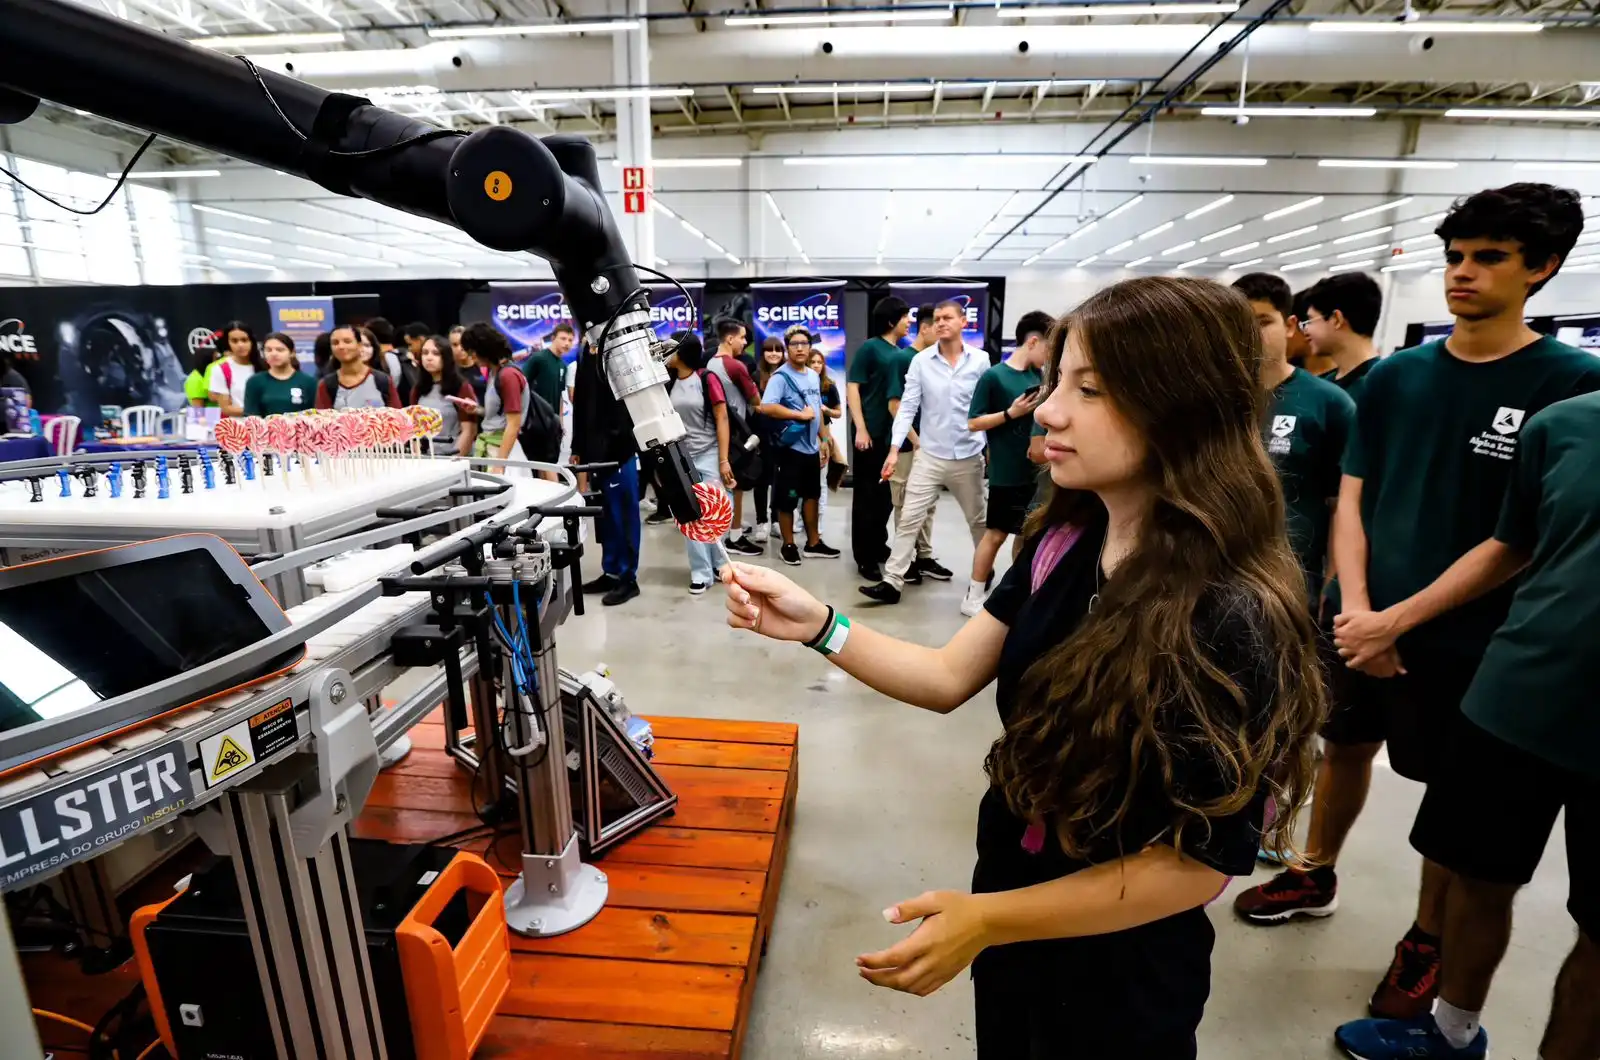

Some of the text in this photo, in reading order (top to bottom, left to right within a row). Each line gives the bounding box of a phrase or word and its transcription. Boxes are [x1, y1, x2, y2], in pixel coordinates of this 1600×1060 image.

[497, 304, 572, 319] SCIENCE
[649, 307, 698, 321] ENCE
[757, 305, 839, 321] SCIENCE
[71, 843, 92, 858] DO
[95, 820, 140, 845] GRUPO
[143, 799, 186, 825] INSOLIT
